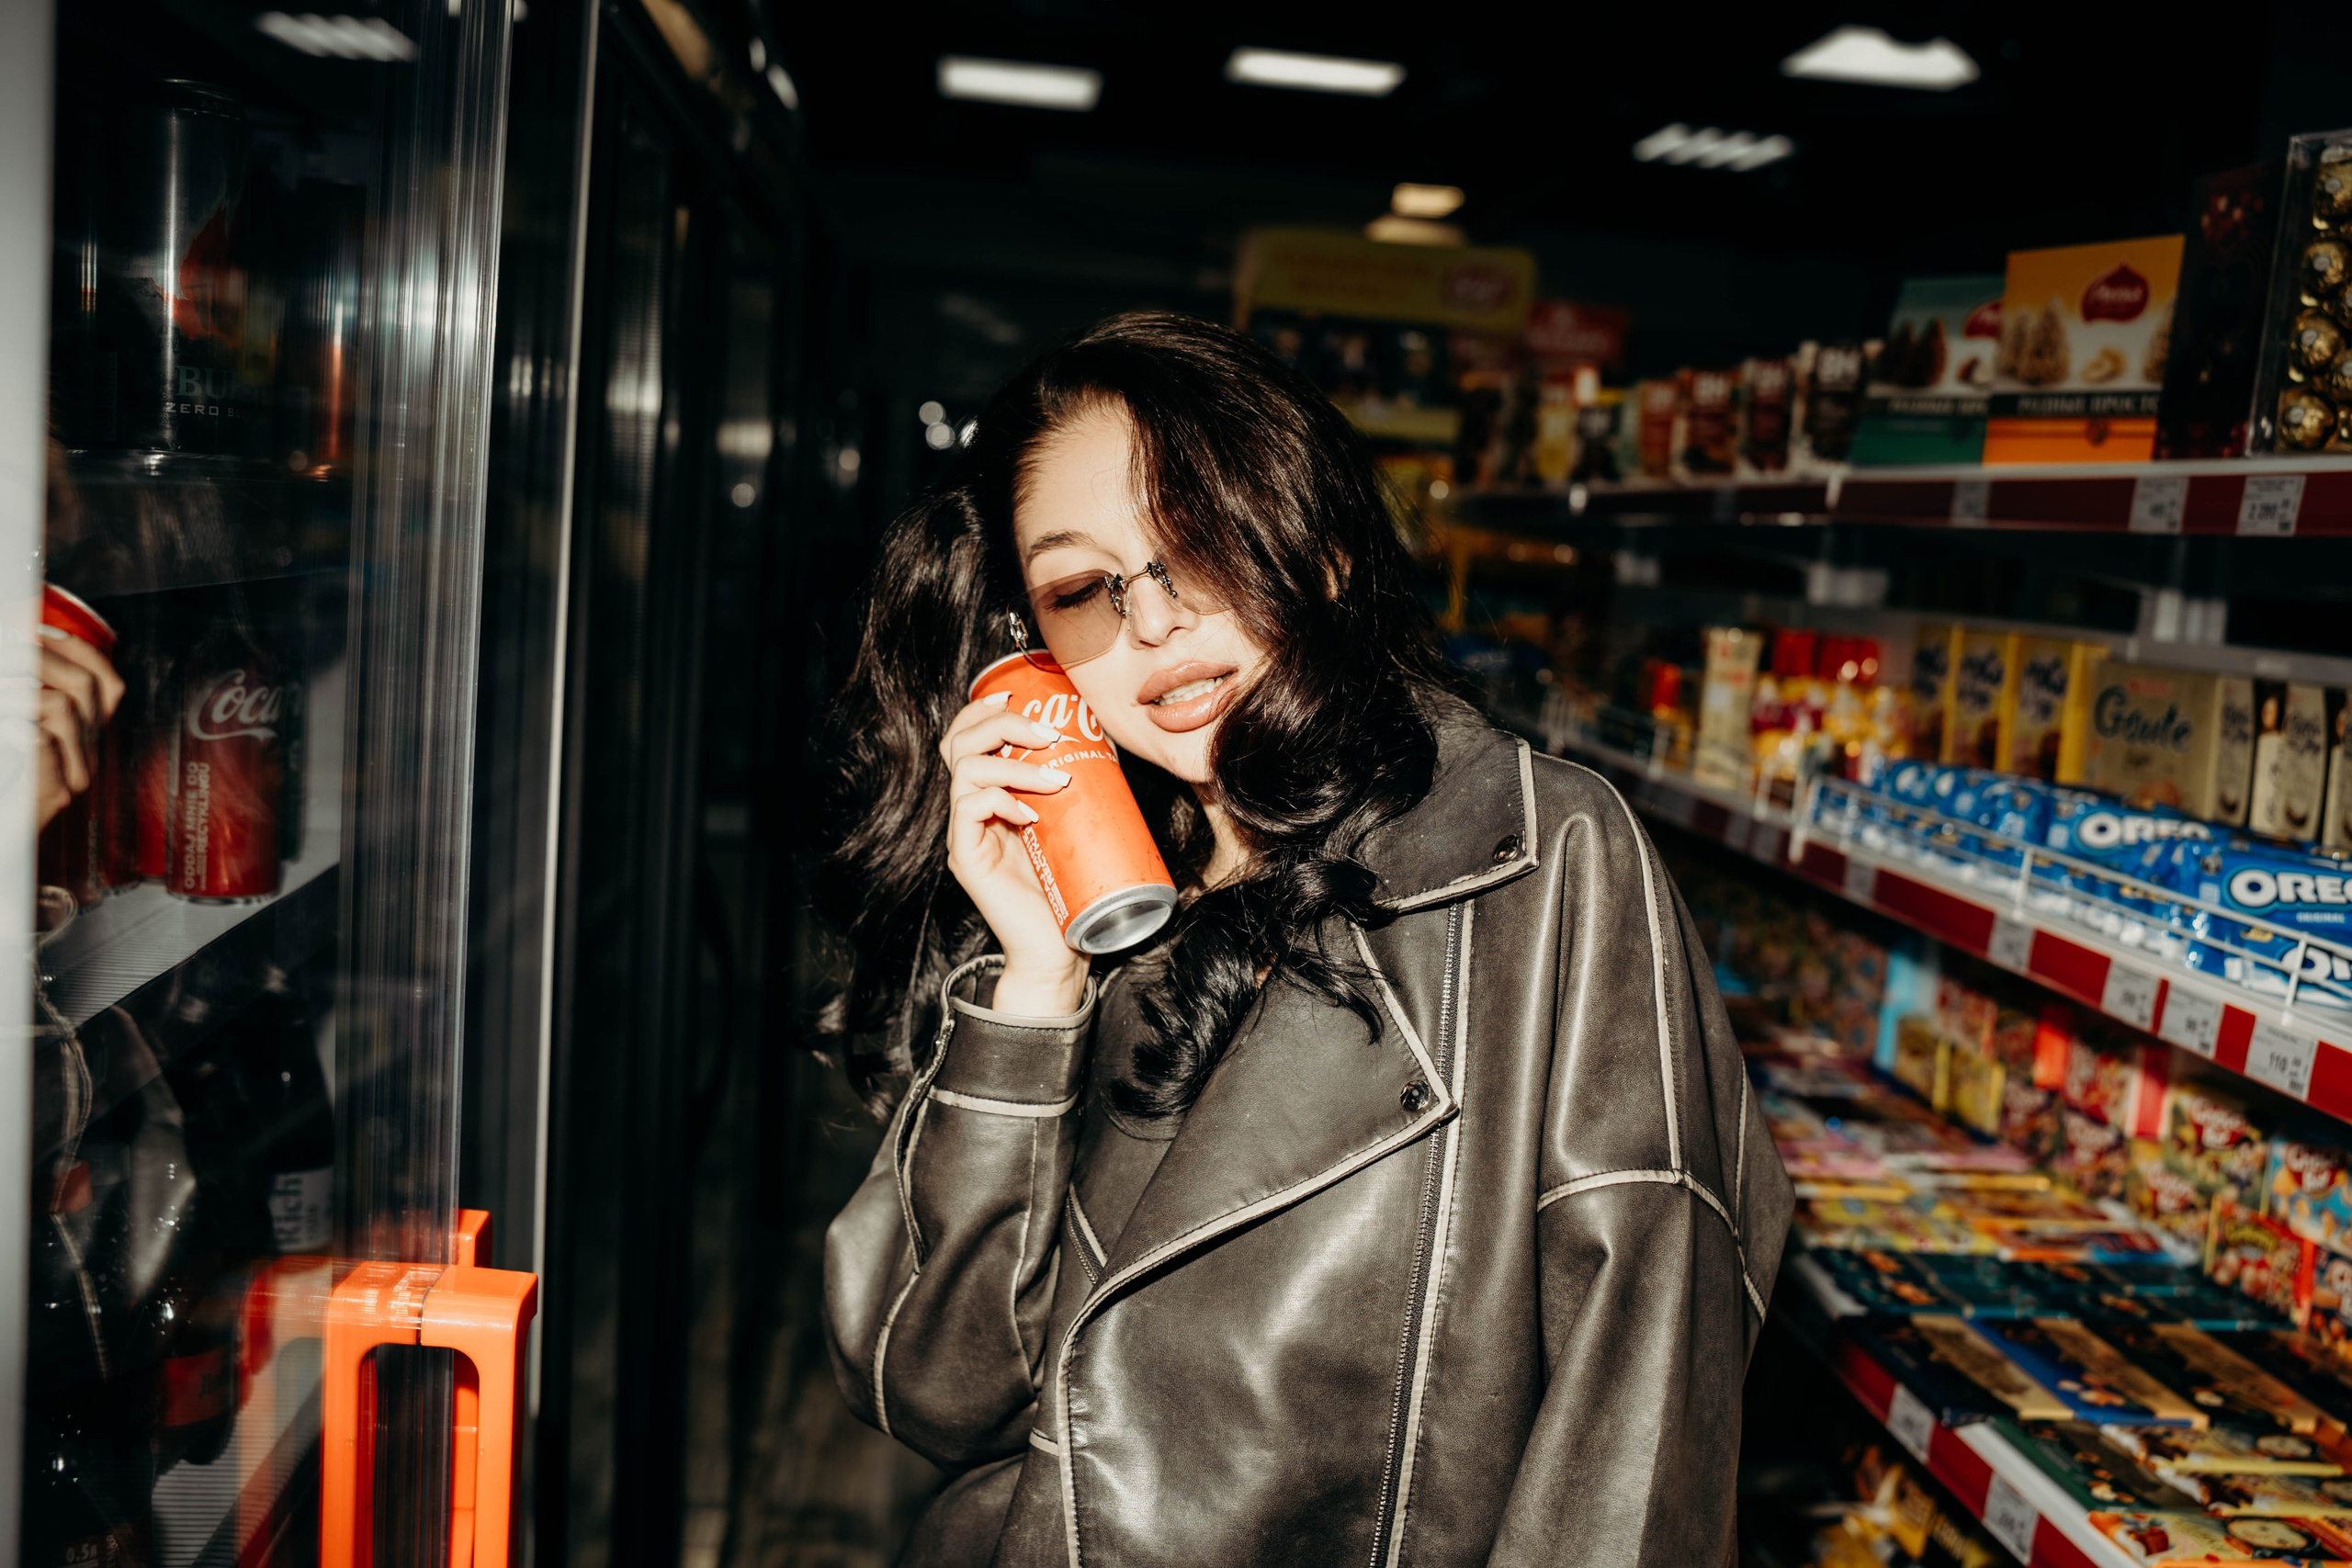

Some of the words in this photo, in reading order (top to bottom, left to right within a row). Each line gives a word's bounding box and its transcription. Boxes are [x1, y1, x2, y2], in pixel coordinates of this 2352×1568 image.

[164, 401, 220, 417] ZERO
[184, 840, 197, 890] ODDAJ
[2230, 868, 2352, 908] ORE
